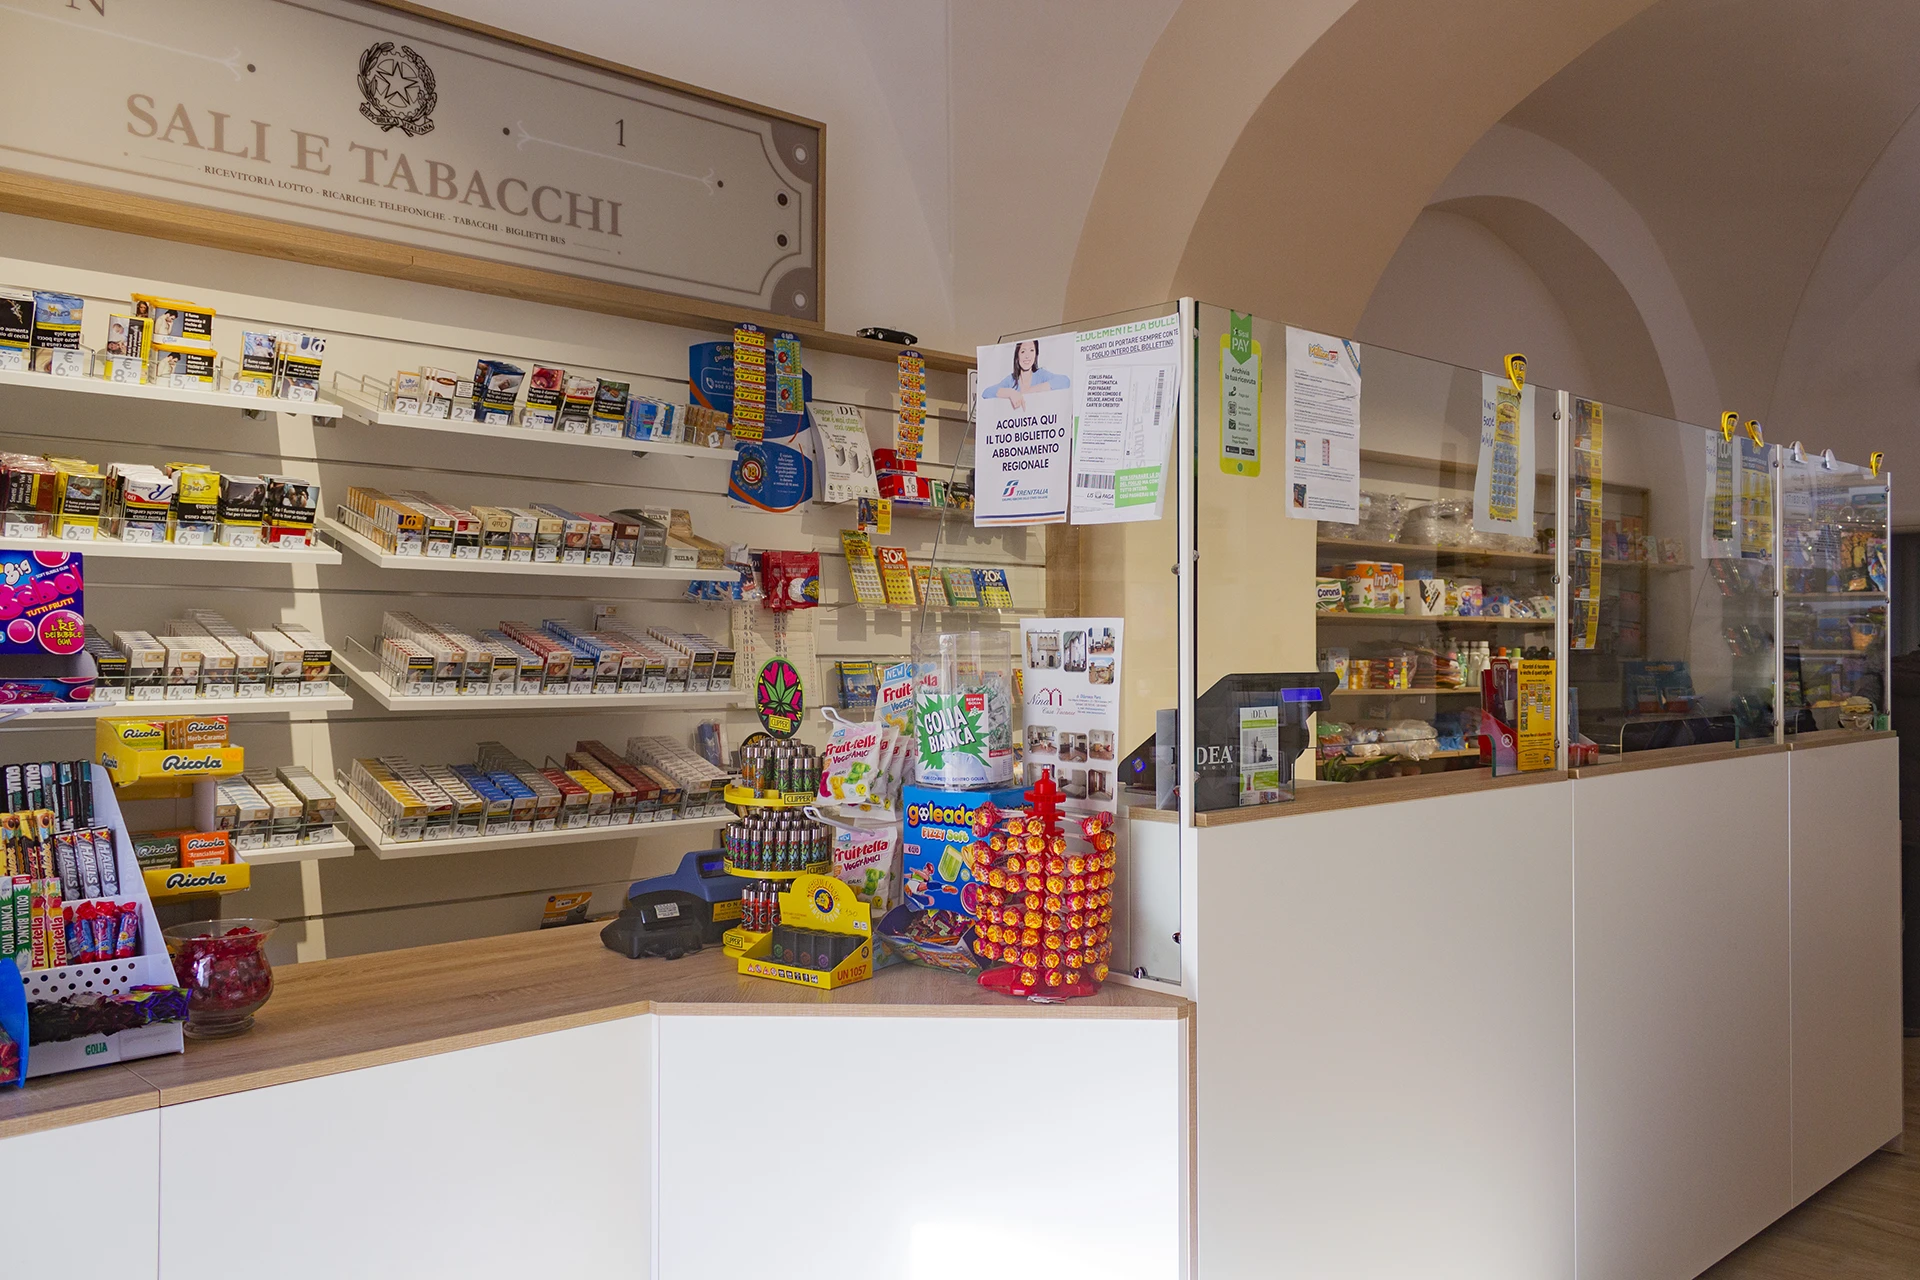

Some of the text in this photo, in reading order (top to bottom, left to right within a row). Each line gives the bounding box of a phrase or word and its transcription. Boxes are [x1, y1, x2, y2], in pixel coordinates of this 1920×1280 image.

[615, 119, 626, 147] 1
[126, 93, 622, 237] SALI E TABACCHI
[204, 165, 566, 245] RICEVITORIA LOTTO RICARICHE TELEFONICHE TABACCHI BIGLIETTI BUS
[1080, 342, 1107, 352] RICORDATI
[1115, 336, 1138, 346] PORTARE
[1139, 332, 1162, 342] SEMPRE
[1162, 329, 1173, 338] CON
[1091, 349, 1109, 359] FOGLIO
[1110, 346, 1129, 356] INTERO
[1141, 338, 1174, 350] BOLLETTINO
[1232, 337, 1250, 352] PAY
[996, 414, 1057, 430] ACQUISTA QUI
[986, 427, 1065, 444] IL TUO BIGLIETTO O
[992, 443, 1059, 458] ABBONAMENTO
[747, 465, 757, 477] 18
[1002, 459, 1049, 471] REGIONALE
[906, 484, 916, 494] 18
[1016, 488, 1048, 496] TRENITALIA
[4, 559, 32, 585] Big
[1373, 572, 1398, 590] Inplù
[1317, 588, 1340, 598] Corona
[26, 597, 75, 617] TUTTI FRUTTI
[886, 664, 904, 680] NEW
[187, 722, 226, 732] Ricola
[770, 718, 790, 730] CLIPPER
[923, 704, 968, 736] GOLIA
[123, 728, 162, 739] Ricola
[187, 733, 227, 741] Herb-Caramel
[928, 726, 976, 754] BIANCA
[825, 734, 877, 757] Fruit-tella
[162, 754, 222, 772] Ricola
[786, 793, 812, 803] CLIPPER
[921, 826, 970, 843] FIZZY Soft
[138, 844, 177, 857] Ricola
[188, 838, 226, 851] Ricola
[833, 840, 889, 863] Fruit-tella
[61, 847, 78, 887] HALLS
[80, 843, 98, 884] HALLS
[98, 841, 116, 882] HALLS
[166, 871, 227, 889] Ricola
[1, 904, 14, 931] BIANCA
[17, 917, 30, 945] BIANCA
[31, 916, 44, 968] Fruit-tella
[51, 916, 66, 968] Fruit-tella
[837, 964, 867, 981] UN 1057
[85, 1042, 108, 1055] GOLIA
